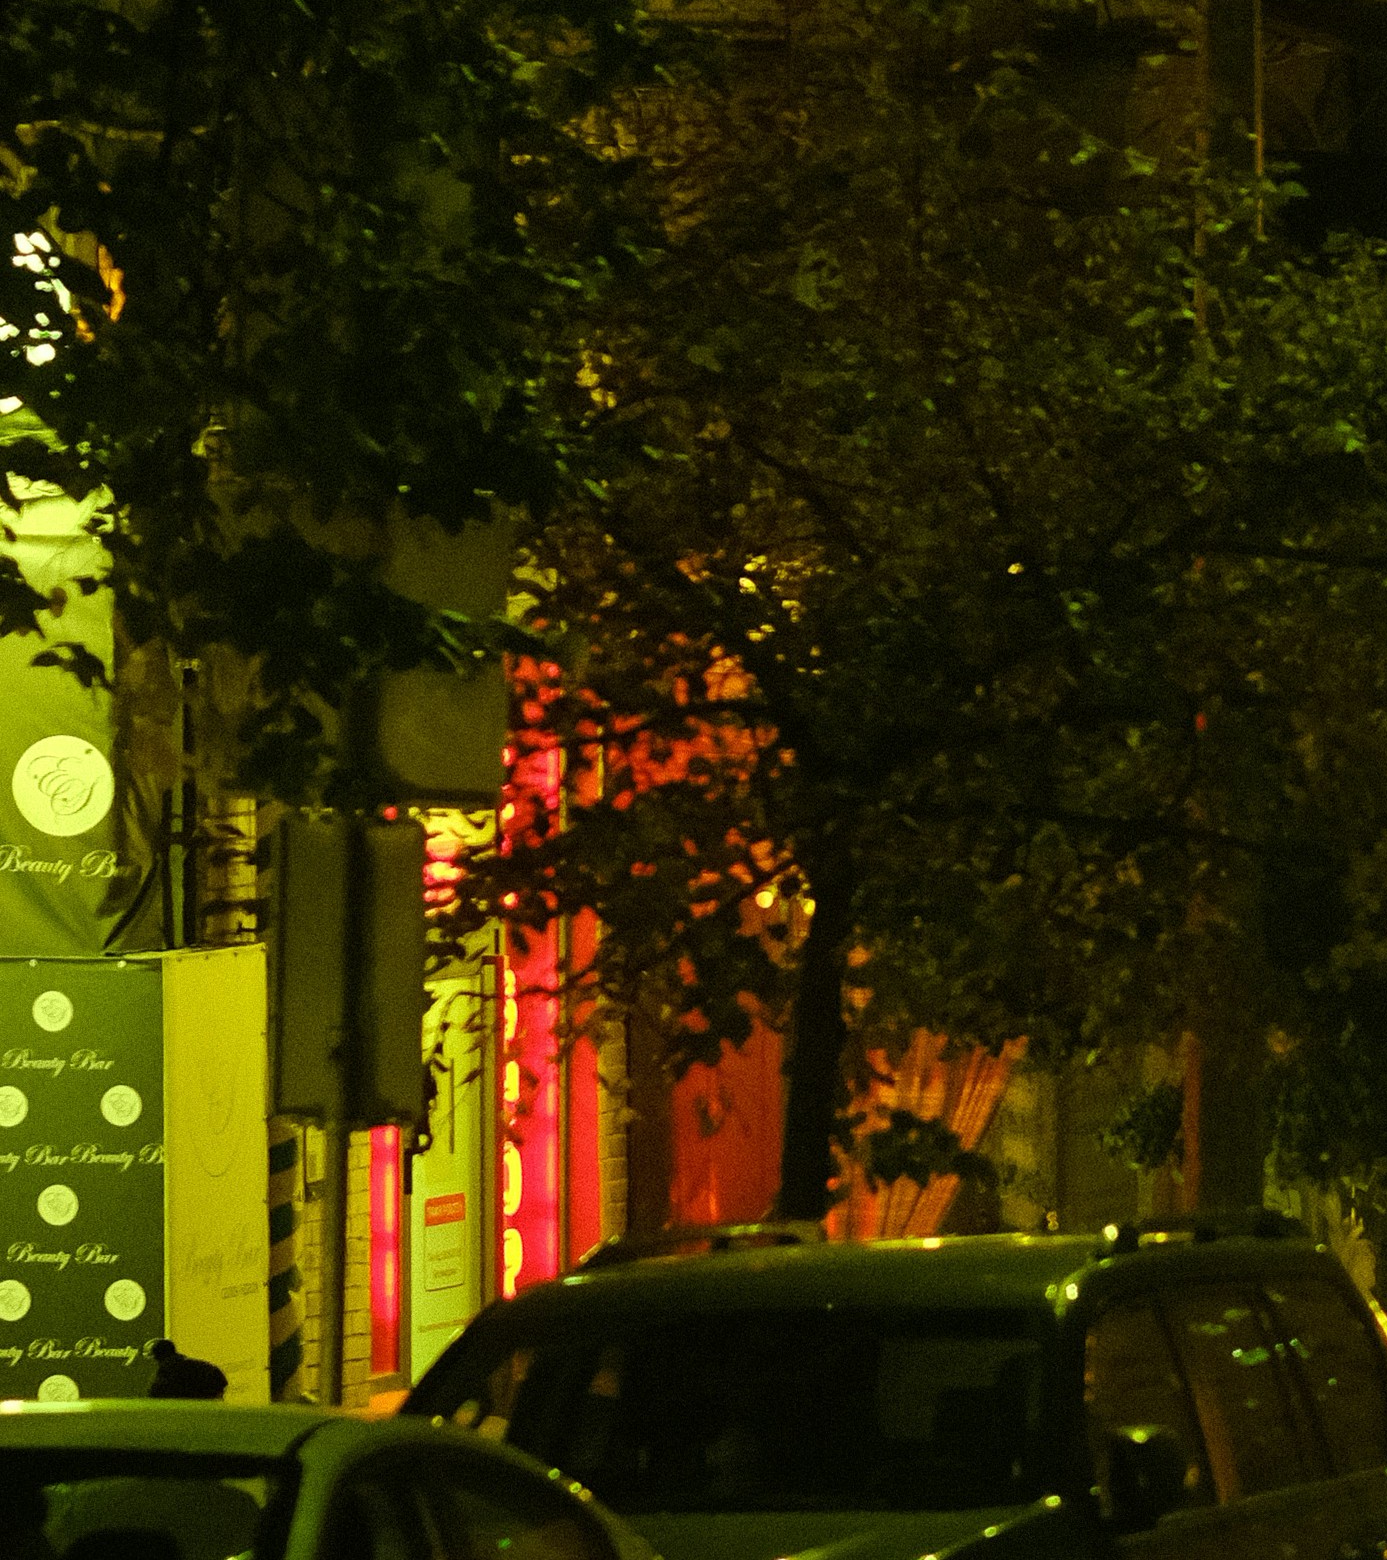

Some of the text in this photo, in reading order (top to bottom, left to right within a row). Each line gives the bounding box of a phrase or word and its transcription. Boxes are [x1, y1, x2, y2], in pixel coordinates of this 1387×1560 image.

[0, 843, 72, 884] Beauty
[1, 1047, 115, 1078] Beauty Bar
[24, 1143, 69, 1165] Bar
[70, 1142, 134, 1172] Beauty
[6, 1241, 120, 1271] Beauty Bar
[27, 1337, 72, 1360] Bar
[74, 1336, 138, 1367] Beauty
